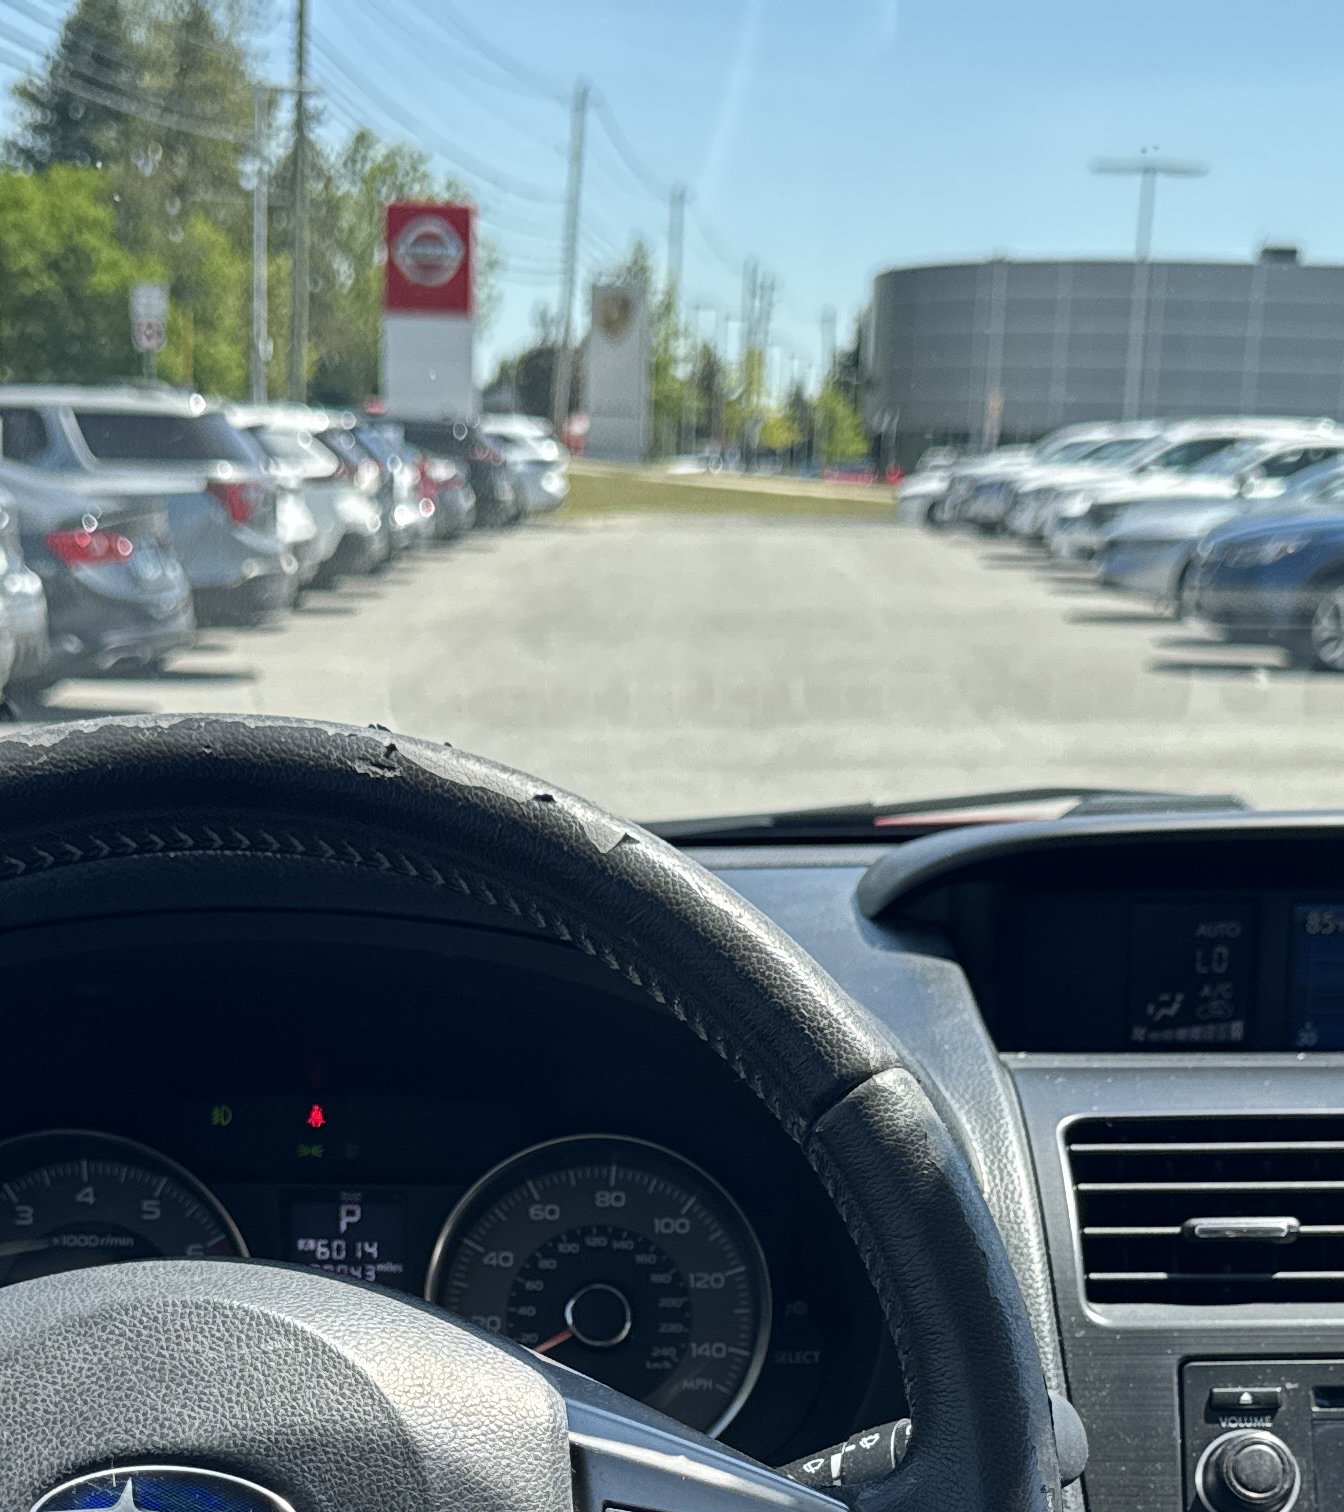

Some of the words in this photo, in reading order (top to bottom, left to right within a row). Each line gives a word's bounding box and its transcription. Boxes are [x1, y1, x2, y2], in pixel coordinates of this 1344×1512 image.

[1194, 921, 1242, 938] AUTO
[76, 1186, 95, 1205] 4
[594, 1191, 626, 1208] 80
[15, 1205, 34, 1226] 3
[142, 1200, 161, 1221] 5
[339, 1203, 362, 1234] P
[529, 1204, 560, 1221] 60
[654, 1218, 690, 1235] 100
[483, 1251, 514, 1268] 40
[689, 1271, 725, 1289] 120
[690, 1342, 727, 1359] 140
[774, 1351, 820, 1365] SELECT
[1219, 1416, 1273, 1428] VOLUME
